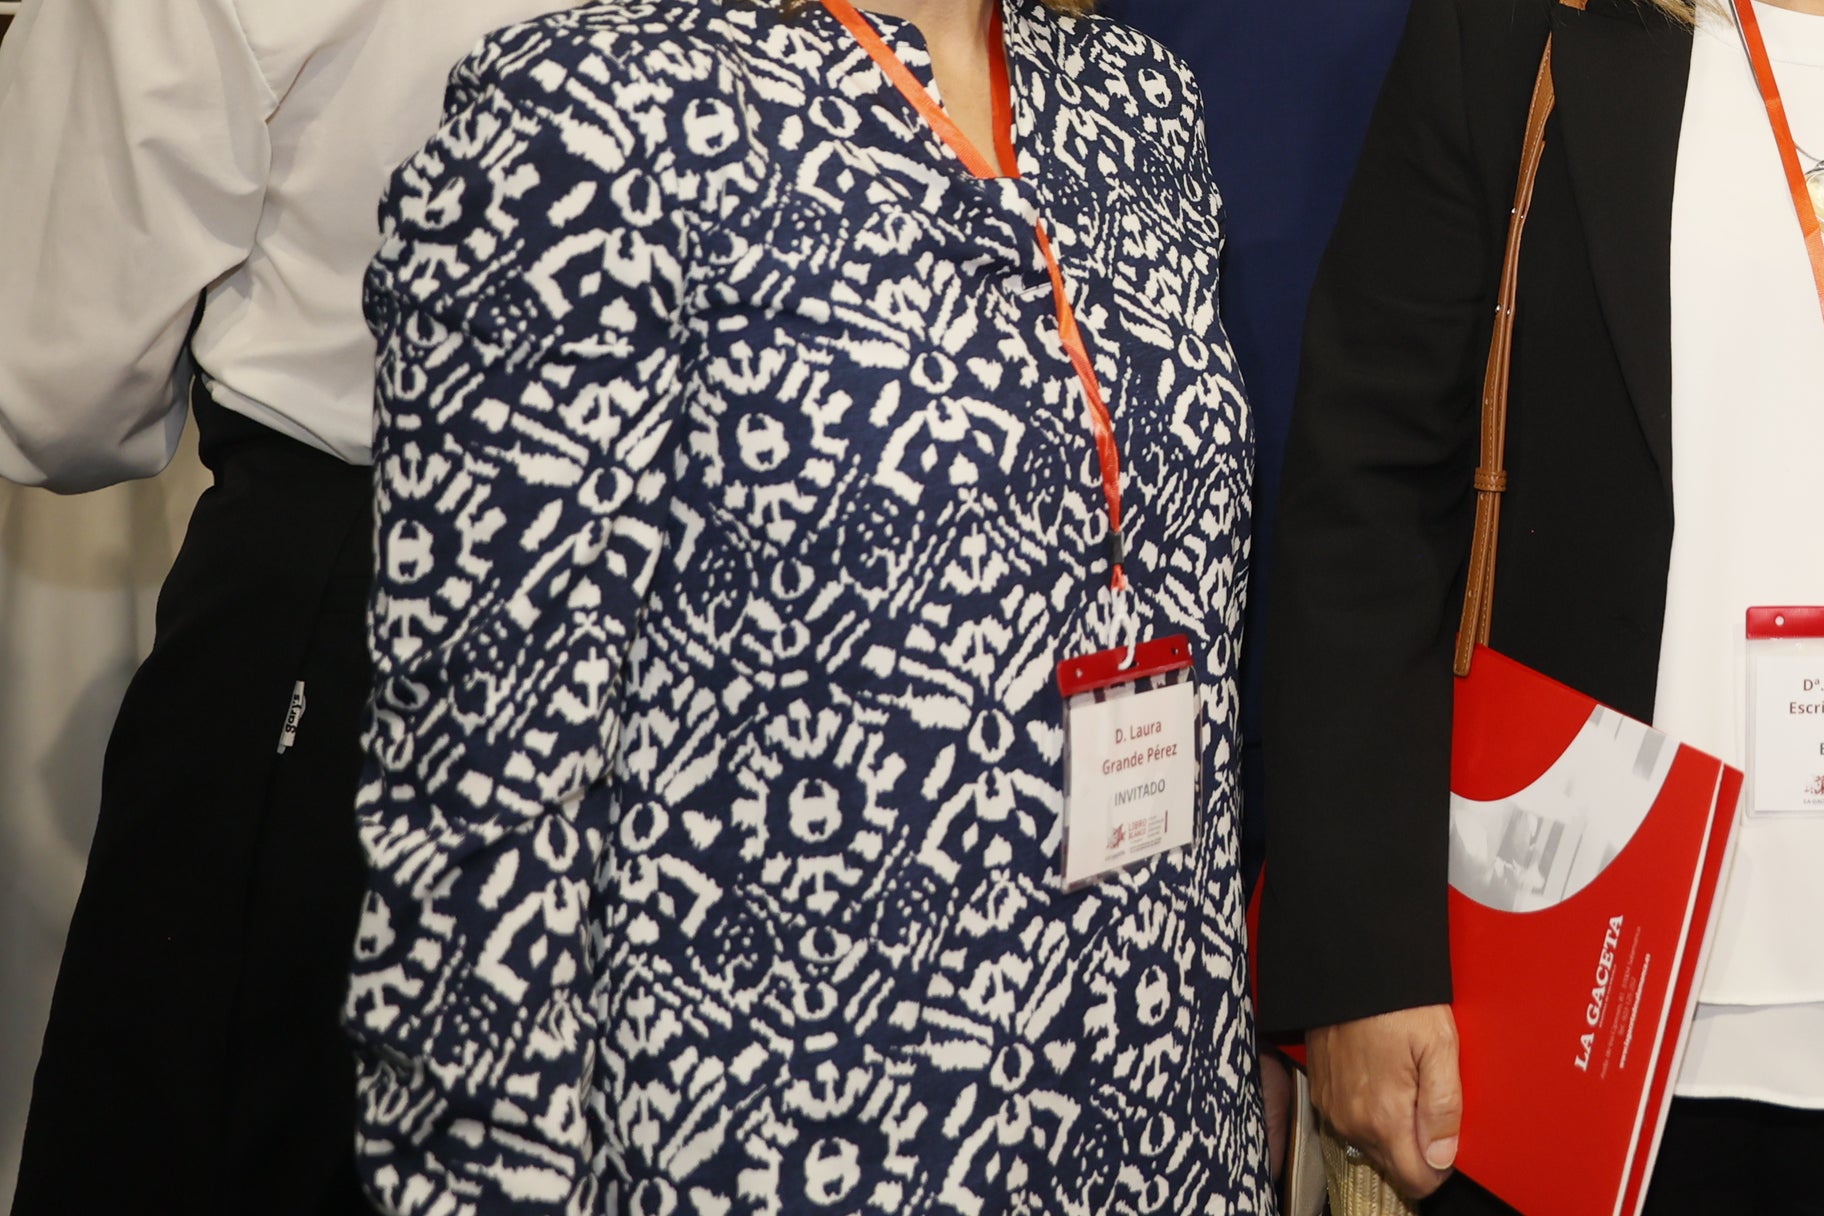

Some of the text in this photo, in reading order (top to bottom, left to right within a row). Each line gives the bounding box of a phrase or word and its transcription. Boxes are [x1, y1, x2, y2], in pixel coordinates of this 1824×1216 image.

[1115, 721, 1162, 745] D. Laura
[1102, 742, 1178, 775] Grande Pérez
[1114, 779, 1165, 806] INVITADO
[1574, 1032, 1595, 1072] LA
[1586, 914, 1624, 1027] GACETA
